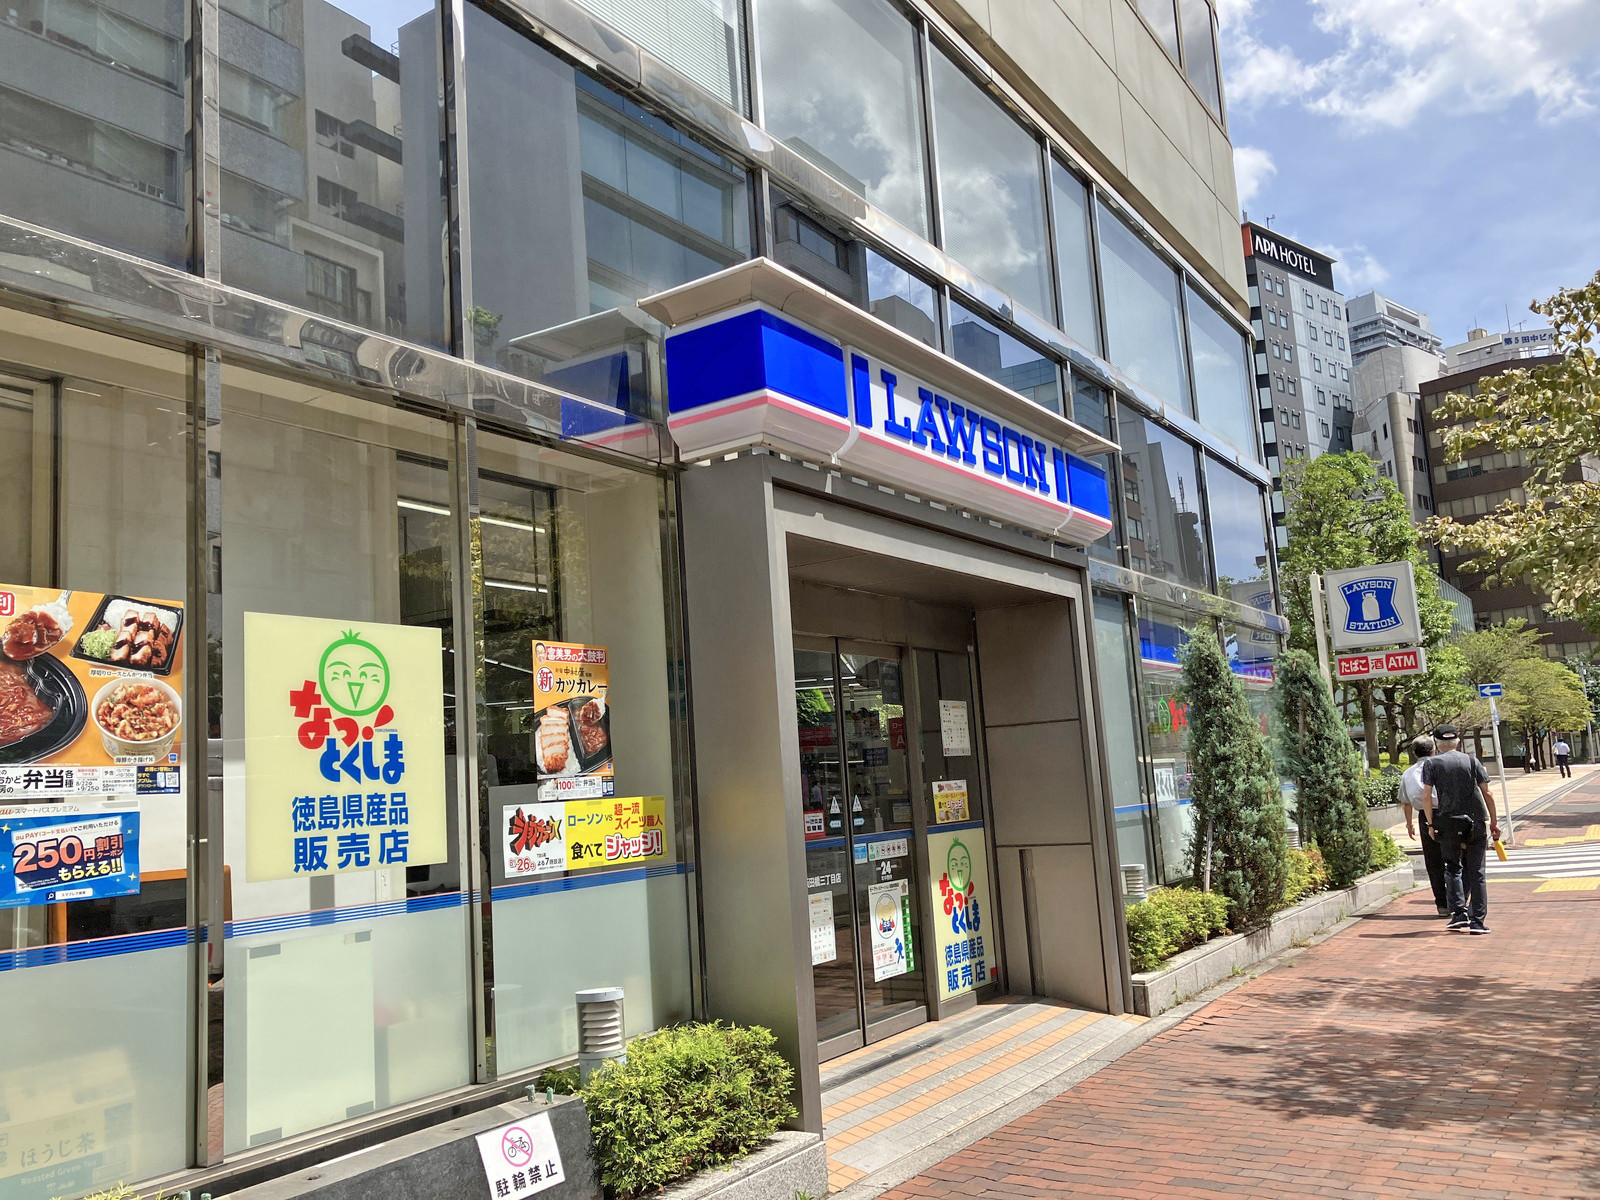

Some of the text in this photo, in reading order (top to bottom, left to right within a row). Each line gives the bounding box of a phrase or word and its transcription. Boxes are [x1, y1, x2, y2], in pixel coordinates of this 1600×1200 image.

[1255, 235, 1317, 276] APA HOTEL
[880, 368, 1051, 494] LAWSON
[1343, 580, 1393, 595] LAWSON
[1349, 616, 1397, 631] STATION
[547, 647, 606, 663] 富美男の太鼓判
[1340, 654, 1416, 673] たばこ 酒 ATM
[539, 670, 553, 691] 新
[556, 678, 608, 693] カツカレー
[319, 733, 405, 785] とくしま
[23, 769, 74, 789] 弁当 各種
[291, 792, 409, 833] 徳島県産品
[614, 802, 640, 816] 超一流
[567, 813, 604, 827] ローソン
[615, 814, 663, 830] スイーツ職人
[95, 835, 123, 851] 割引
[293, 830, 409, 873] 販売店
[571, 842, 603, 860] 食べて
[605, 829, 663, 861] ジャッジ!
[97, 850, 123, 859] クーポン
[58, 858, 122, 881] もらえる!!
[881, 861, 891, 874] 24
[951, 899, 981, 934] とくしま
[945, 936, 984, 967] 徳島県産品
[947, 960, 986, 992] 販売店
[20, 1131, 96, 1168] ほうじ茶
[20, 1169, 55, 1185] Roasted
[57, 1163, 81, 1176] Green
[496, 1160, 558, 1198] 駐輪禁止
